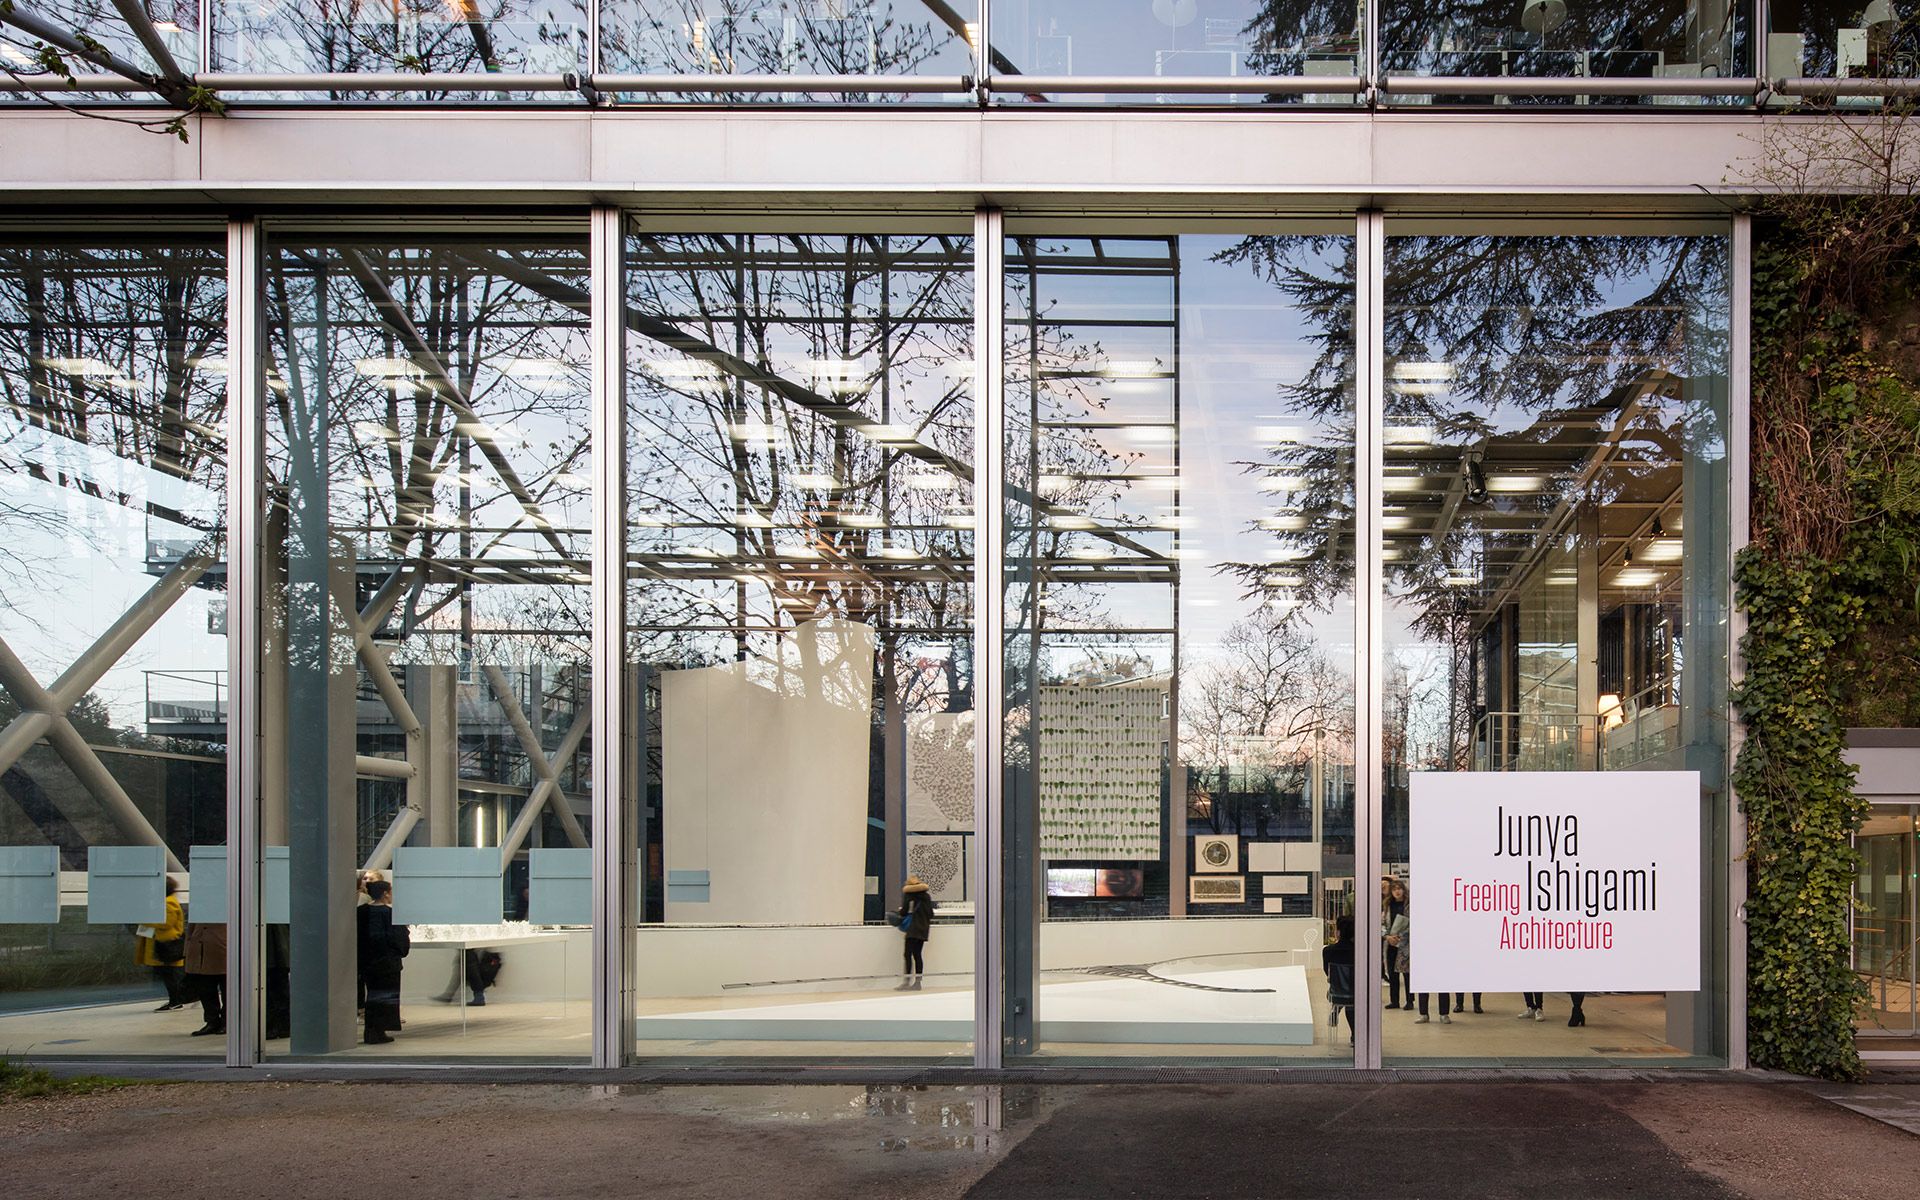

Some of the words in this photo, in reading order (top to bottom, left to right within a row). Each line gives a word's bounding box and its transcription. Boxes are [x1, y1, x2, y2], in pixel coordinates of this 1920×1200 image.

[1494, 805, 1578, 862] Junya
[1454, 878, 1520, 916] Freeing
[1527, 860, 1656, 918] Ishigami
[1500, 916, 1613, 950] Architecture
